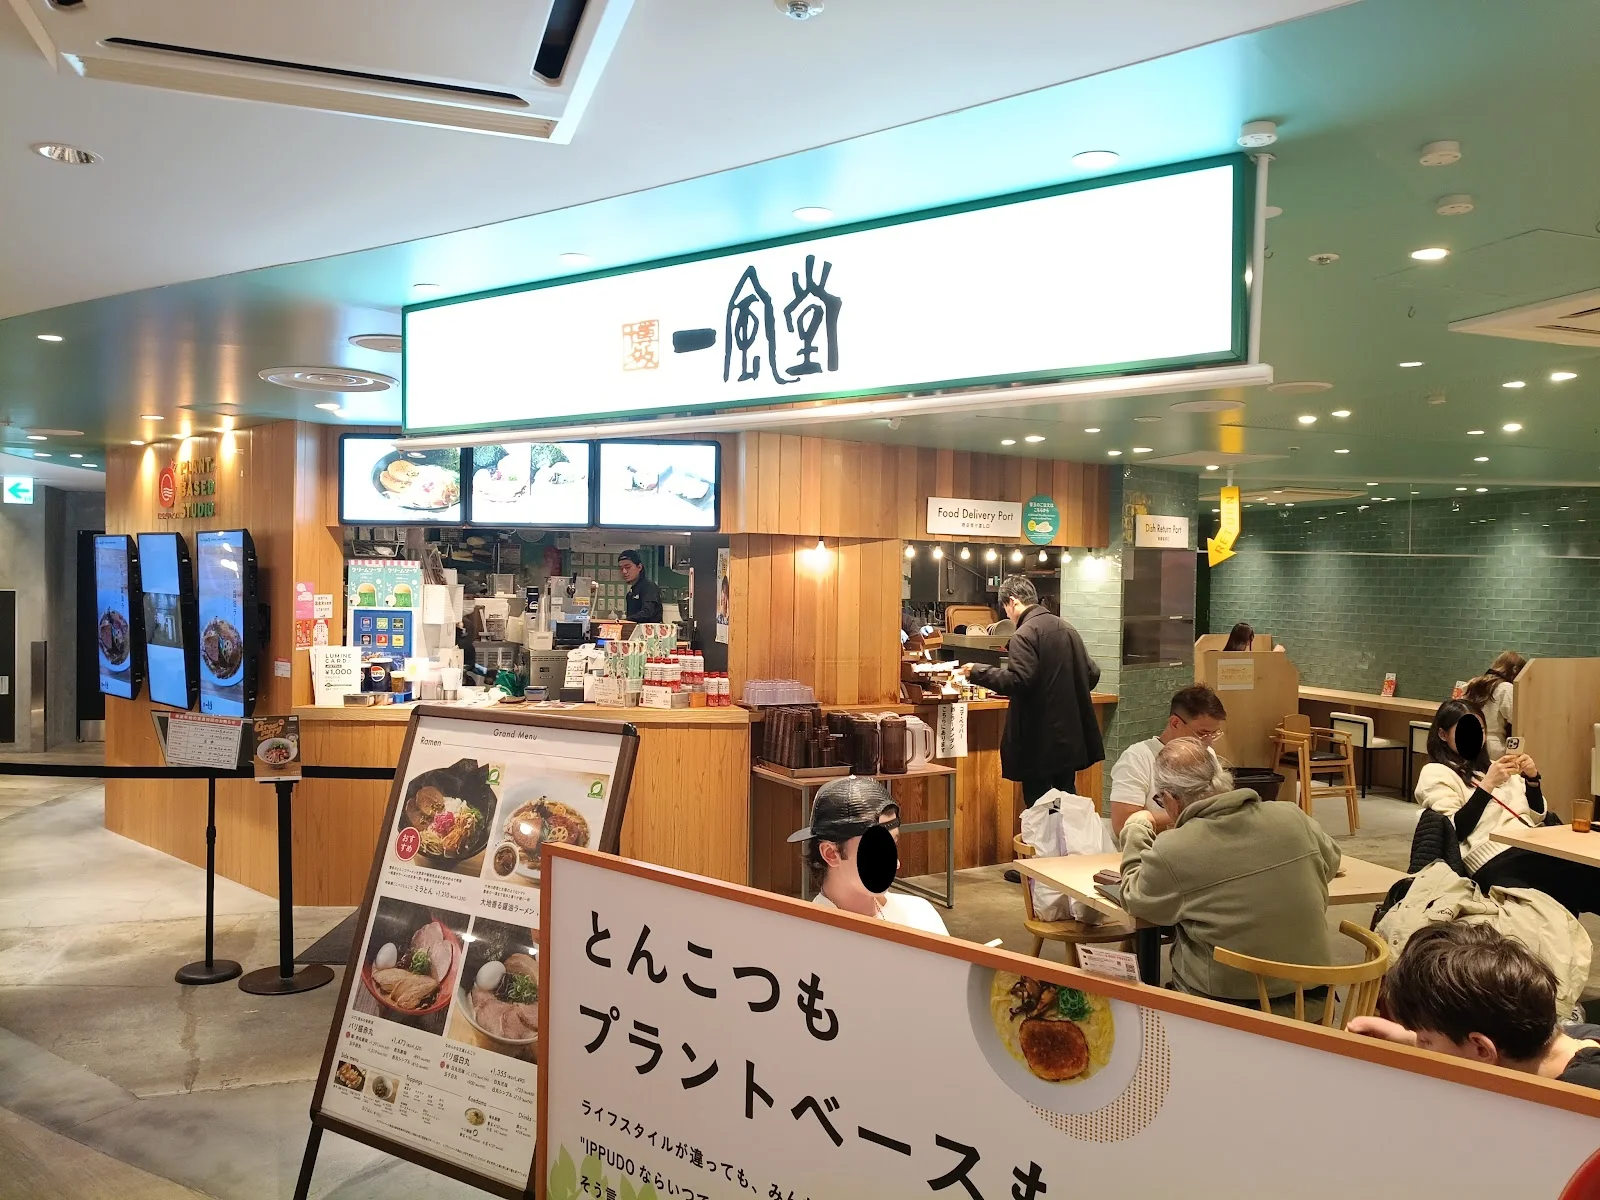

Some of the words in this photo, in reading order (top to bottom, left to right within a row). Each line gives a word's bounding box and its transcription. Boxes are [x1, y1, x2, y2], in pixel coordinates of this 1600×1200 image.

[673, 254, 842, 384] 一風堂
[181, 457, 212, 475] PLANT
[180, 479, 214, 497] BASED
[180, 502, 214, 518] STUDIO
[938, 507, 959, 519] Food
[962, 509, 995, 522] Delivery
[998, 510, 1014, 521] Port
[1145, 523, 1156, 533] Dish
[1157, 524, 1172, 534] Return
[1173, 525, 1182, 534] Port
[420, 737, 442, 747] Ramen
[493, 729, 516, 739] Grand
[518, 731, 538, 741] Menu
[414, 884, 433, 896] ミラとん
[480, 899, 534, 915] 大地香る醤油ラーメン
[585, 911, 840, 1041] とんこつも
[340, 1052, 349, 1060] Side
[406, 1074, 423, 1086] Toppings
[518, 1112, 532, 1122] Drinks
[581, 1100, 812, 1200] ライフスタイルが違っても、みん
[639, 1165, 709, 1200] ならいつ
